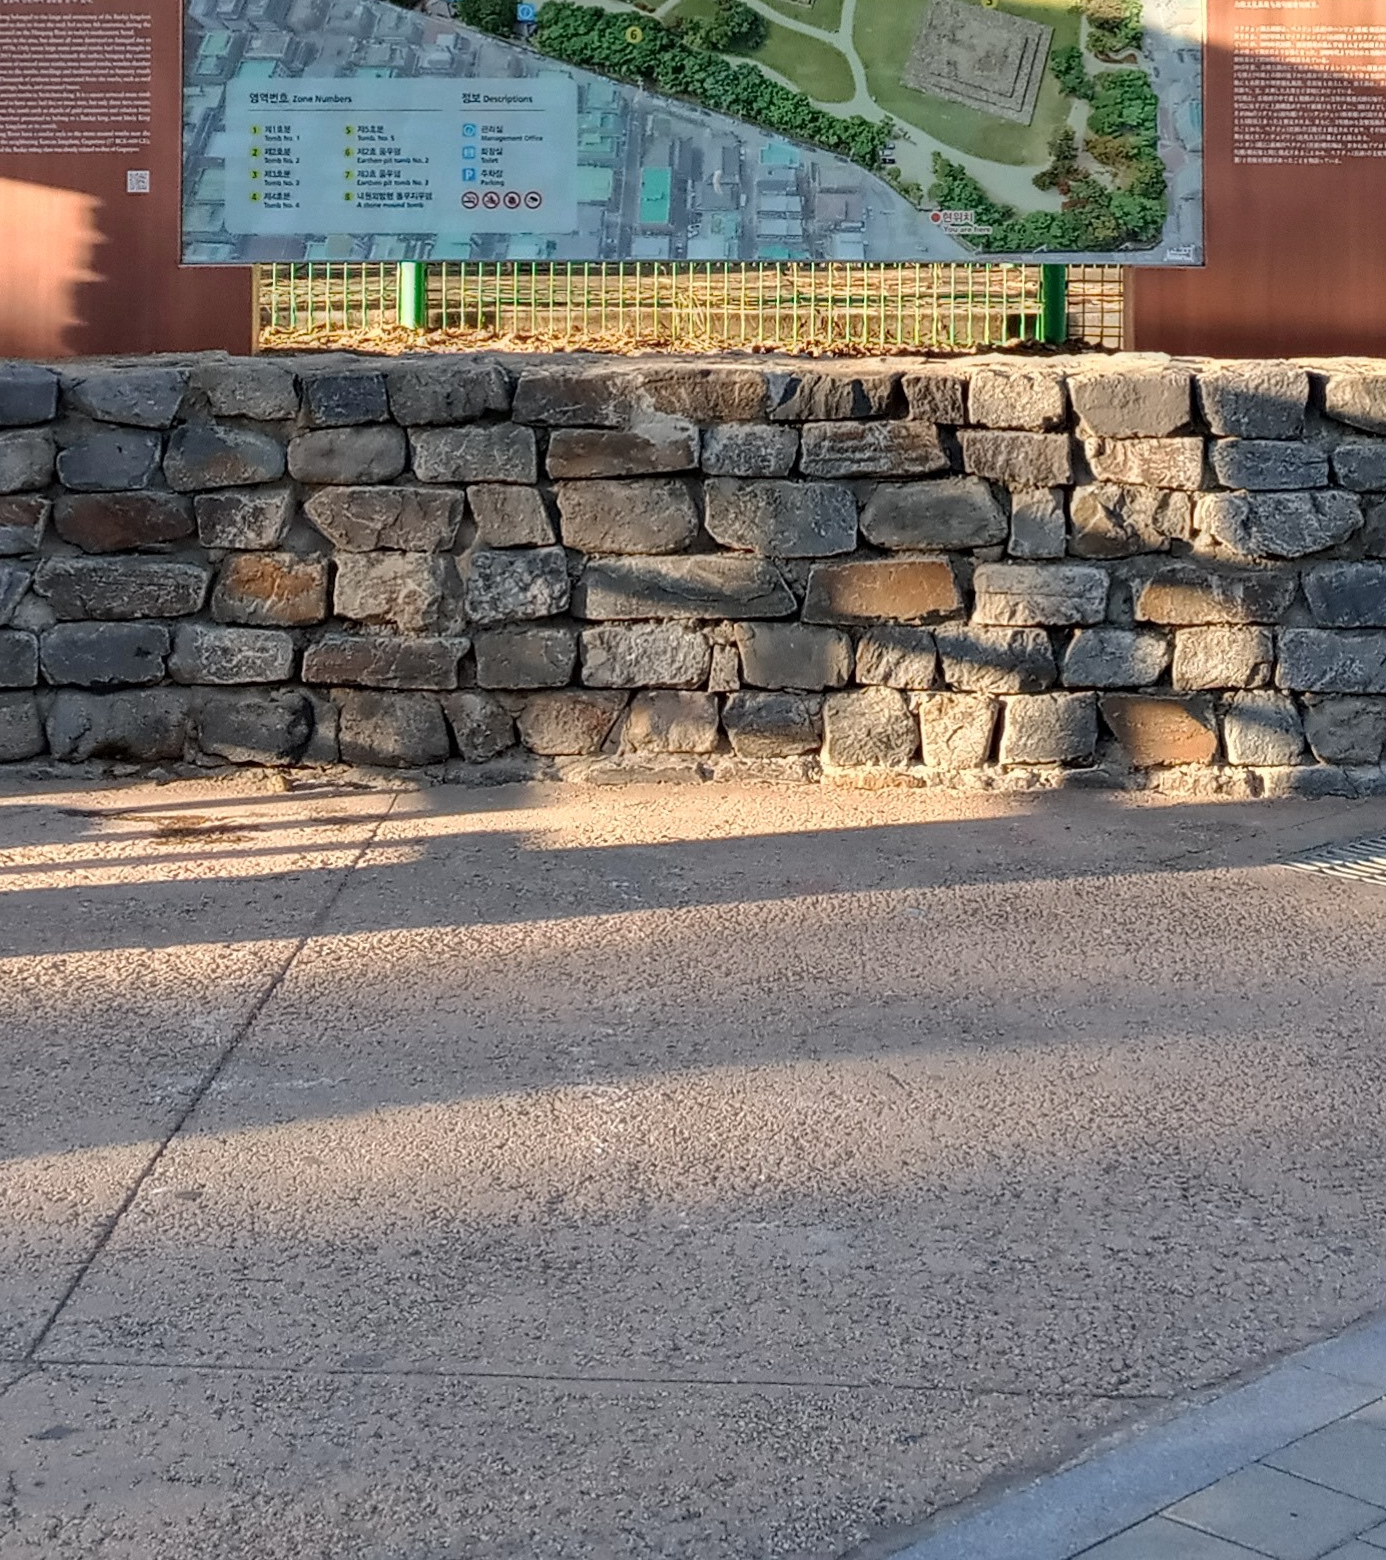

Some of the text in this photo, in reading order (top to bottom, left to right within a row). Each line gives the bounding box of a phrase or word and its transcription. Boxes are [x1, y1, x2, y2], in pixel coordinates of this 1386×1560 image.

[249, 92, 352, 104] 영역번호 Zone Numbers
[461, 92, 533, 104] 정보 Descriptions
[943, 212, 973, 223] 현위치
